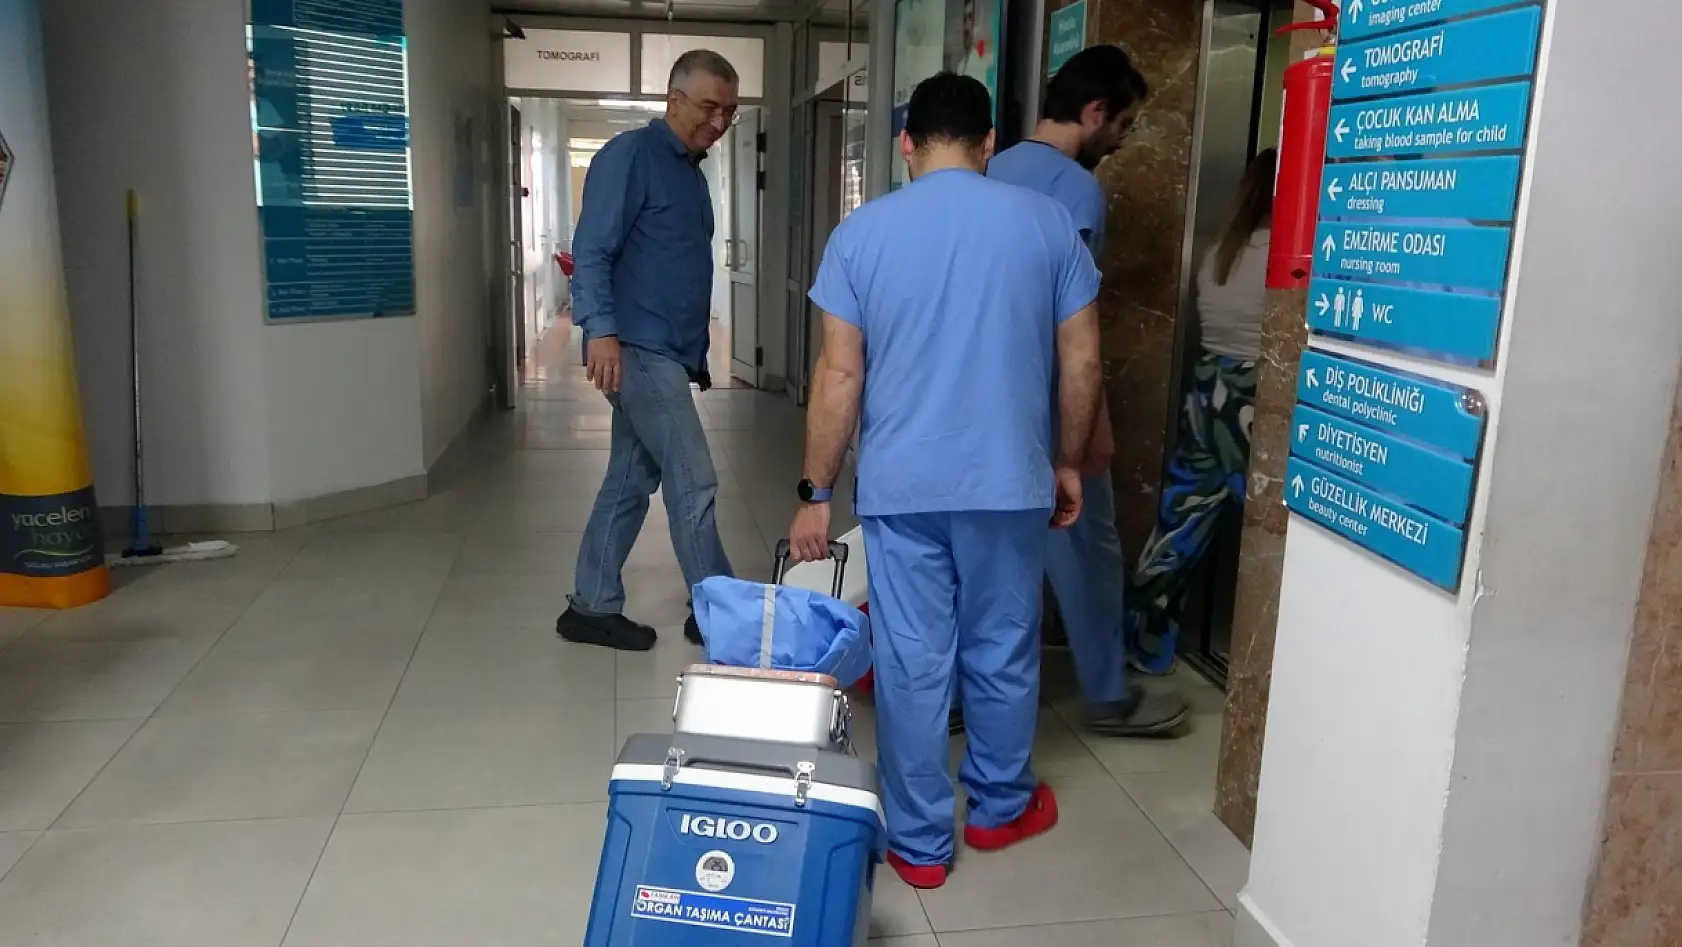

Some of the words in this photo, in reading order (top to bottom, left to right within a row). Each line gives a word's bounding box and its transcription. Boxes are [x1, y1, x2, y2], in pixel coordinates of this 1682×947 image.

[1368, 6, 1406, 26] imaging
[1408, 0, 1443, 17] center
[1363, 30, 1444, 68] TOMOGRAFİ
[1361, 67, 1419, 88] tomography
[1356, 106, 1401, 134] ÇOCUK
[1405, 102, 1436, 126] KAN
[1437, 98, 1480, 124] ALMA
[1354, 134, 1382, 152] taking
[1384, 131, 1413, 147] blood
[1414, 129, 1452, 148] sample
[1456, 127, 1473, 143] for
[1475, 124, 1508, 143] child
[1349, 171, 1378, 196] ALÇI
[1380, 169, 1457, 191] PANSUMAN
[1347, 195, 1385, 214] dressing
[1343, 227, 1400, 254] EMZİRME
[1402, 234, 1446, 257] ODASI
[1340, 256, 1374, 274] nursing
[1375, 260, 1400, 275] room
[1372, 302, 1394, 325] WC
[1325, 364, 1344, 392] DİŞ
[1322, 390, 1350, 412] dental
[1351, 401, 1397, 426] polyclinic
[1318, 421, 1388, 465] DİYETİSYEN
[1315, 446, 1363, 476] nutritionist
[1308, 497, 1338, 523] beauty
[1339, 514, 1369, 537] center
[1311, 476, 1367, 517] GÜZELLİK
[1370, 502, 1429, 546] MERKEZİ
[680, 813, 779, 845] IGLOO
[636, 900, 683, 917] ORGAN
[686, 906, 731, 922] TAŞIMA
